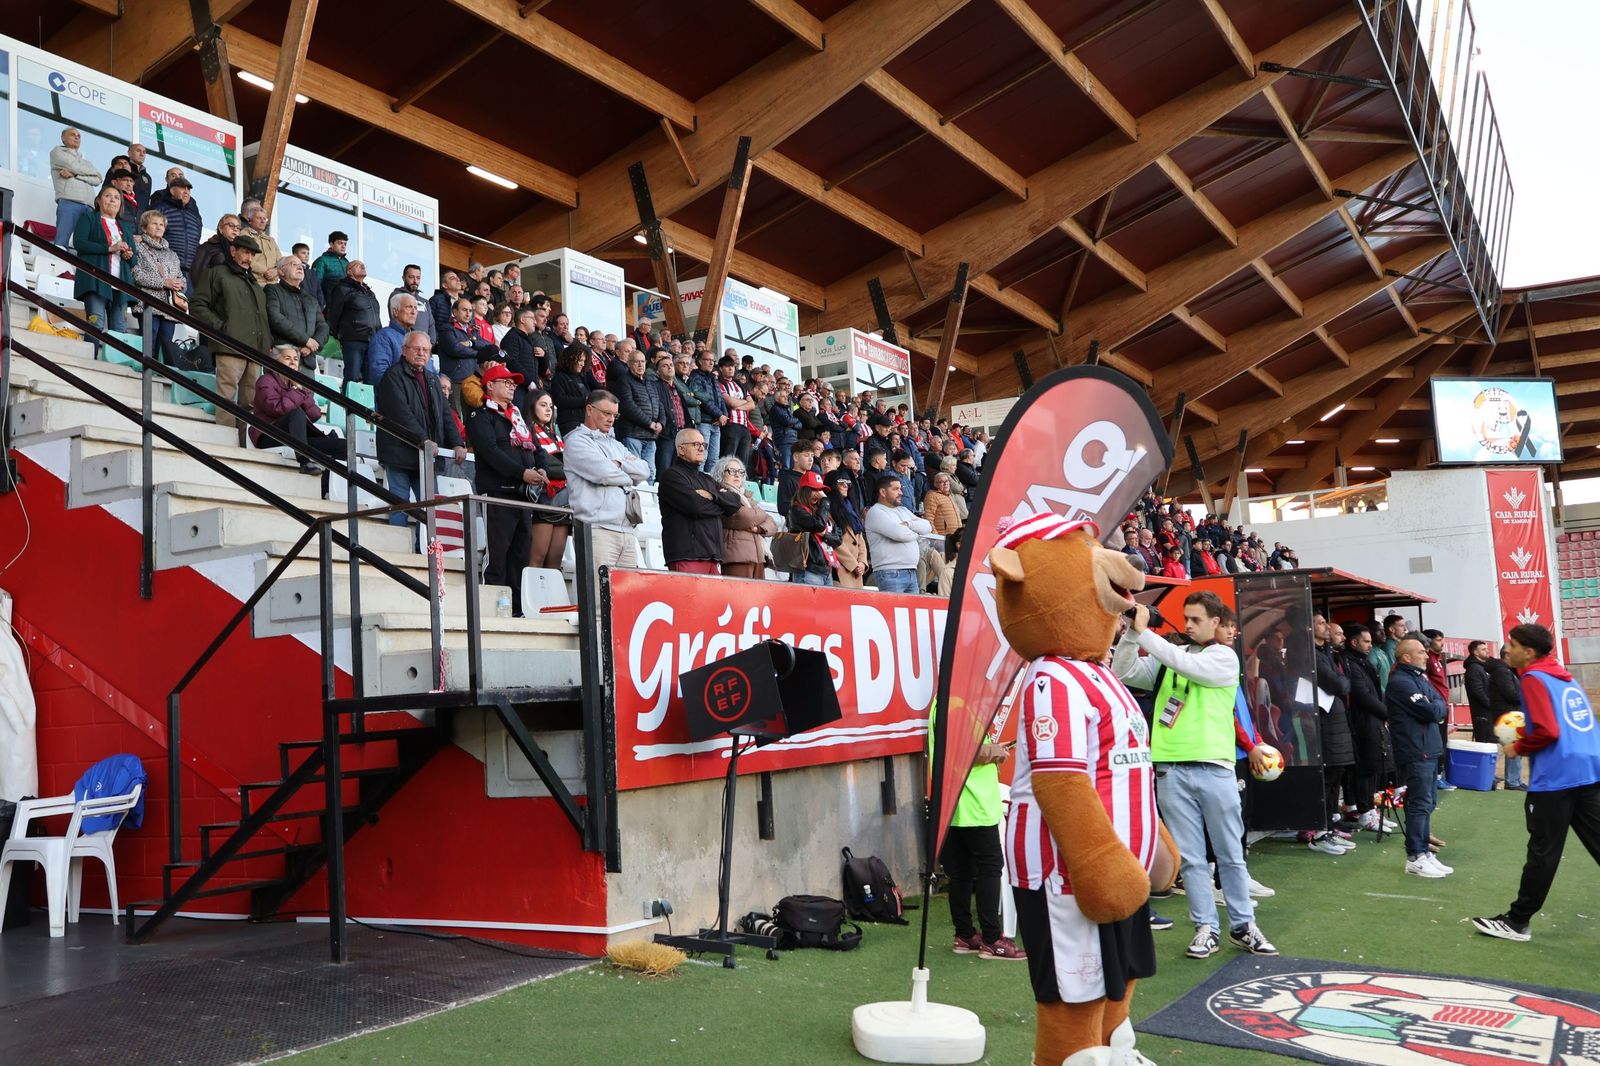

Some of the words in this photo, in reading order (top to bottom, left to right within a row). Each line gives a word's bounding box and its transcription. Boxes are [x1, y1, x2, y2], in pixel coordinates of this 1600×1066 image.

[67, 80, 107, 106] COPE
[150, 110, 184, 129] cyltv.es
[282, 155, 313, 177] ZAMORA
[315, 167, 336, 185] NEWS
[336, 175, 355, 192] ZN
[287, 171, 330, 196] Zamora
[373, 188, 385, 204] La
[680, 289, 705, 303] EMAS
[1495, 510, 1513, 519] CAJA
[1513, 510, 1538, 519] RURAL
[1501, 571, 1520, 580] CAJA
[1520, 570, 1545, 579] RURAL
[850, 604, 949, 715] DU
[1113, 752, 1140, 765] CAJA
